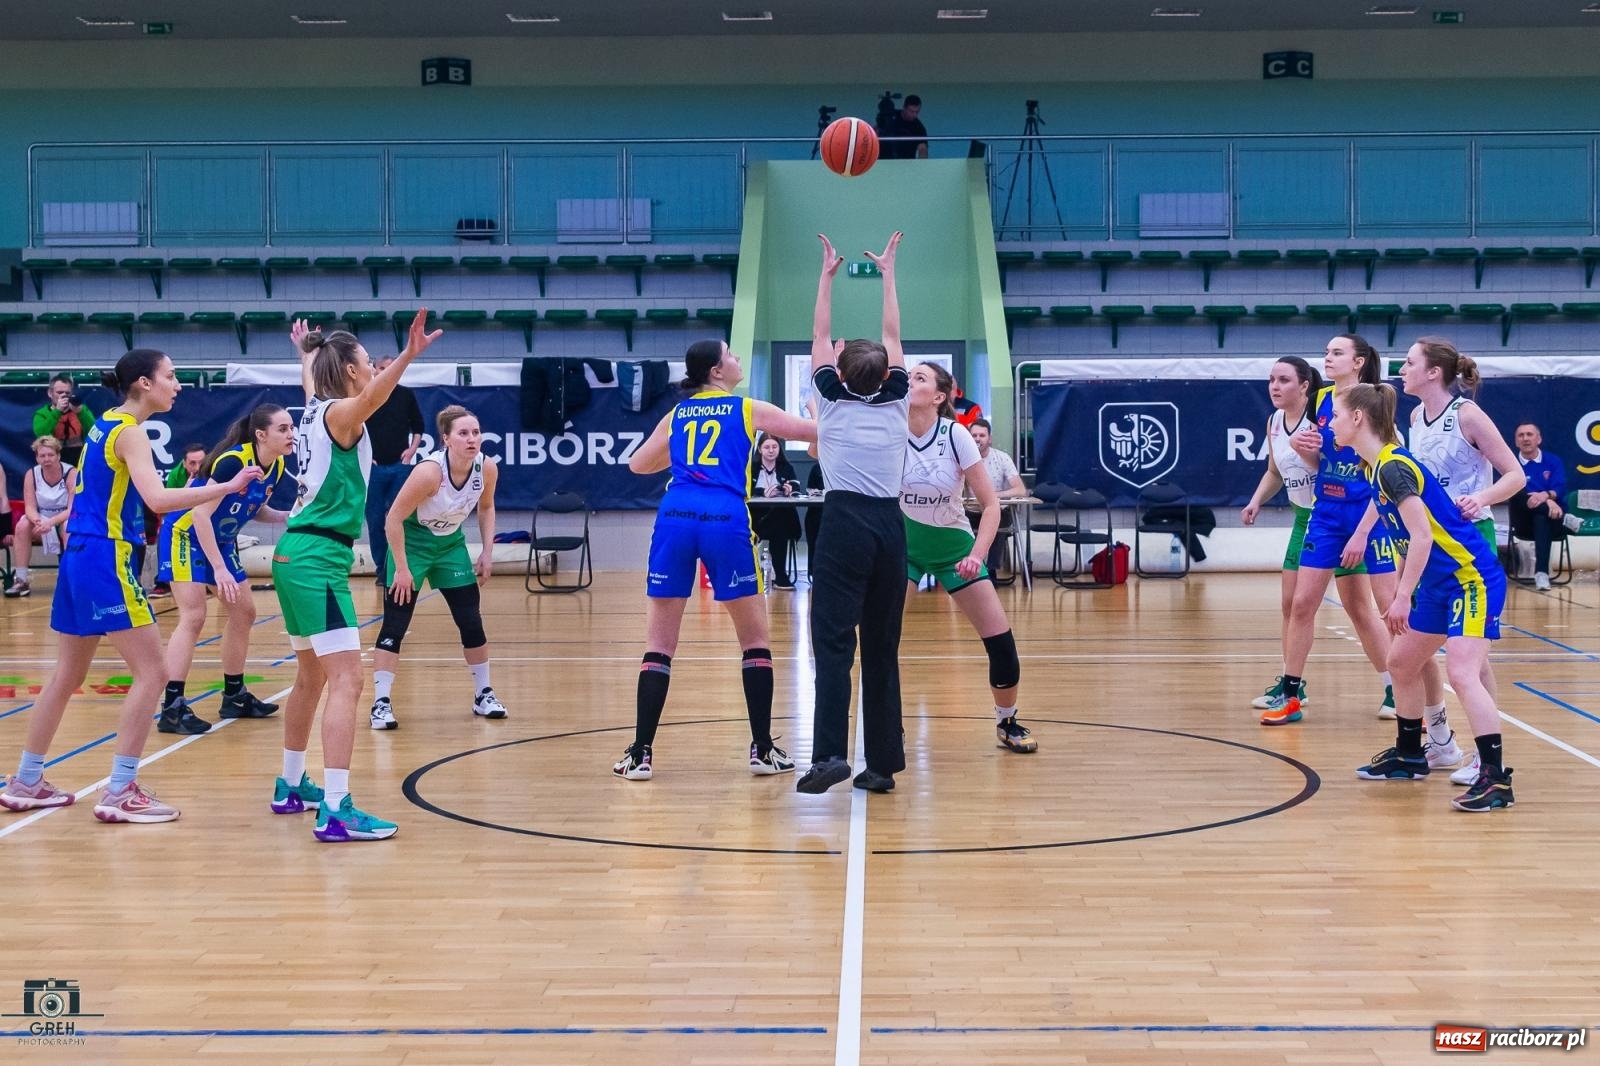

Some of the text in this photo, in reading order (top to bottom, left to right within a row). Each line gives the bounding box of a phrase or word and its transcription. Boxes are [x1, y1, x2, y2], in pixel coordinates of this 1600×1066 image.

[426, 67, 437, 82] B
[449, 66, 464, 81] B
[1268, 60, 1286, 75] C
[1297, 60, 1310, 75] C
[677, 404, 733, 419] GŁUCHOŁAZY
[1443, 416, 1455, 431] 9
[409, 421, 645, 466] RCIBÓRZ
[683, 419, 721, 466] 12
[937, 440, 947, 456] 7
[904, 492, 951, 505] Clavis
[1371, 537, 1392, 560] 14
[1452, 598, 1463, 622] 9
